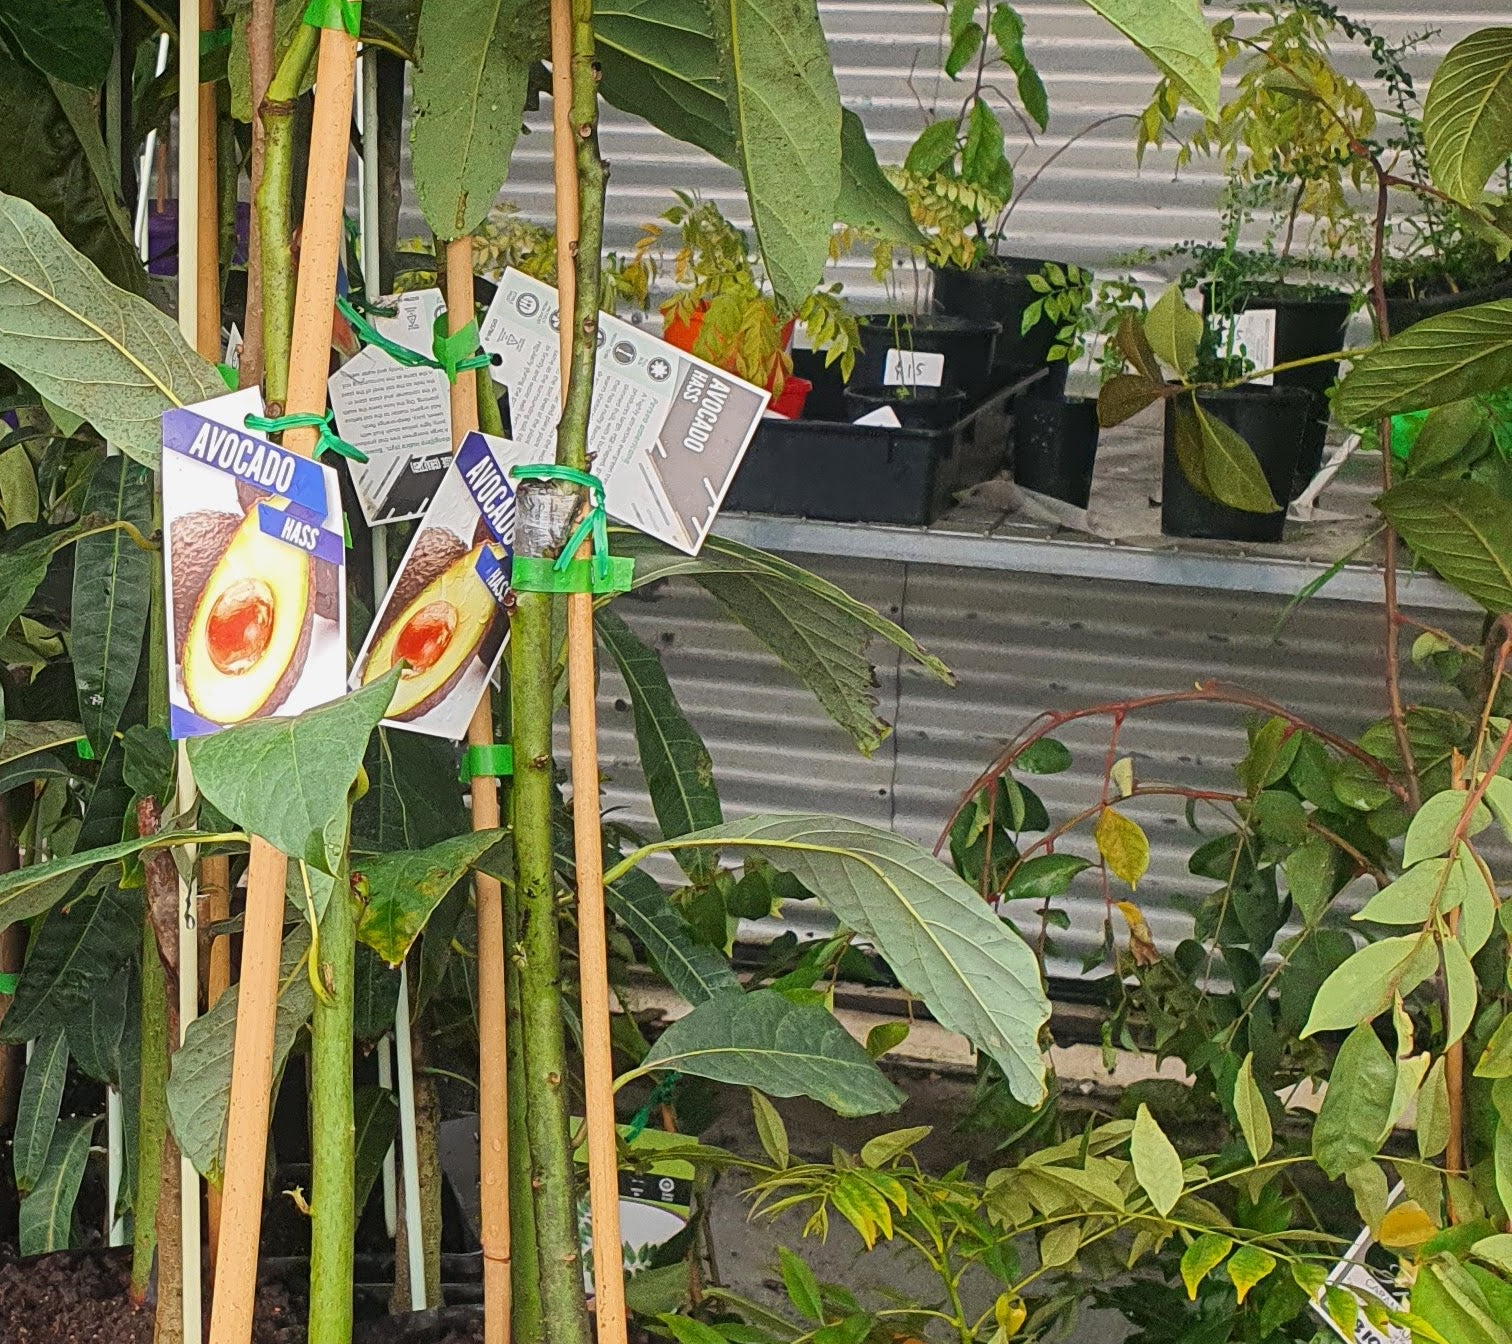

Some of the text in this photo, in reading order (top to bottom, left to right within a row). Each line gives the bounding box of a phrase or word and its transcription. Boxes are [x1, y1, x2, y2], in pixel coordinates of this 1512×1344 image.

[681, 370, 709, 403] HASS
[682, 377, 731, 454] AVOCADO
[188, 421, 297, 494] AVOCADO
[280, 516, 321, 551] HASS
